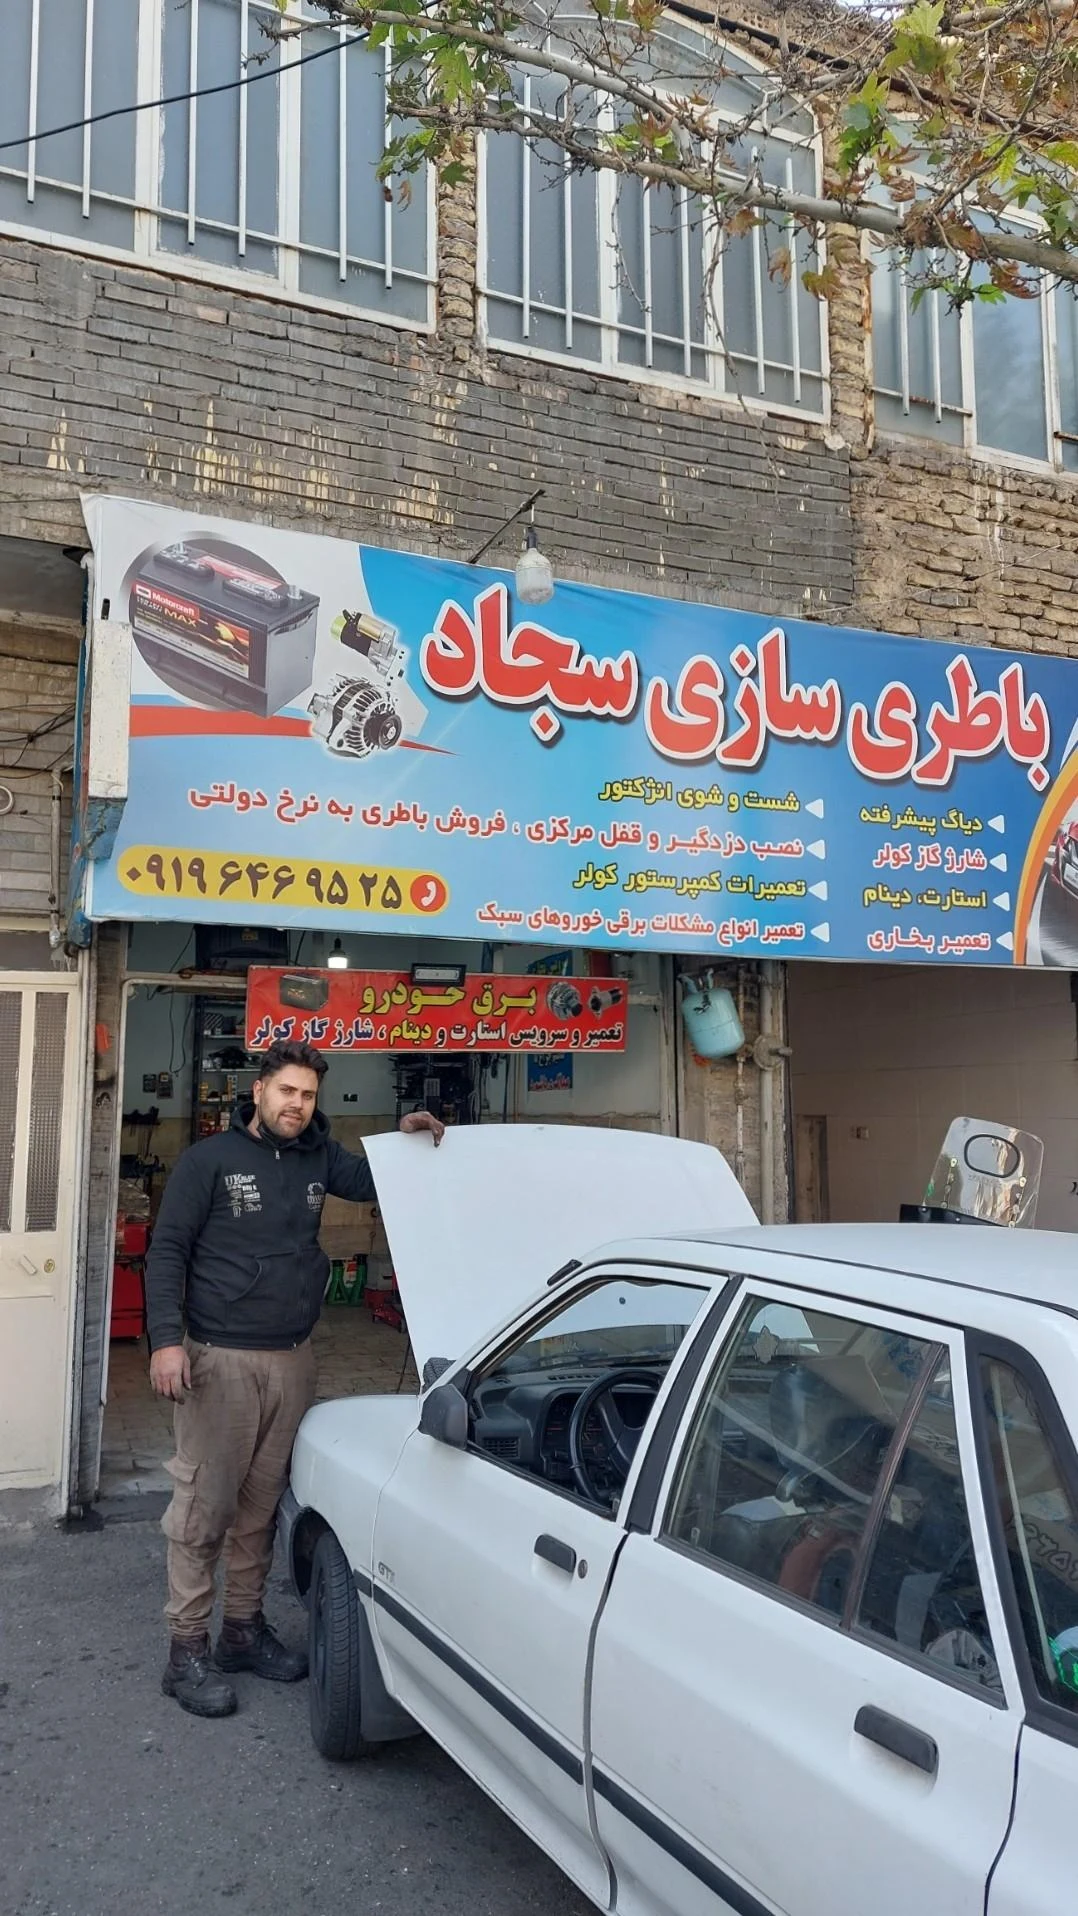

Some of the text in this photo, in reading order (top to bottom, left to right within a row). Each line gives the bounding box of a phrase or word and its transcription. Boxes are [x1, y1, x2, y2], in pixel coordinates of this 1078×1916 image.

[164, 608, 197, 628] MAX
[420, 582, 1051, 791] باطری سازی سجاد
[189, 782, 268, 811] دولتی
[276, 788, 320, 823] نرخ
[598, 776, 800, 813] شست و شوی انژکتور
[327, 798, 353, 823] به
[361, 802, 428, 831] باطری
[435, 807, 507, 837] فروش
[860, 803, 983, 836] دیاگ پیشرفته
[527, 817, 593, 844] مرکزی
[600, 822, 642, 848] قفل
[649, 831, 659, 851] و
[666, 826, 746, 857] دزدگیر
[752, 838, 804, 860] نصب
[872, 842, 987, 872] شارژ گاز کولر
[573, 863, 807, 902] تعمیرات کمپرستور کولر
[863, 883, 913, 909] دینام
[478, 902, 522, 925] سبک
[607, 910, 647, 936] برقی
[651, 914, 715, 936] مشکلات
[719, 920, 757, 945] انواع
[762, 921, 804, 942] تعمیر
[868, 925, 991, 955] تعمیر بخاری
[472, 982, 537, 1017] برق
[249, 1015, 296, 1047] کولر
[300, 1016, 330, 1044] گاز
[330, 1016, 375, 1047] شارژ
[389, 1018, 432, 1047] دینام
[434, 1026, 448, 1048] و
[450, 1020, 507, 1047] استارت
[509, 1025, 569, 1048] سرویس
[569, 1028, 581, 1048] و
[582, 1021, 624, 1048] تعمیر
